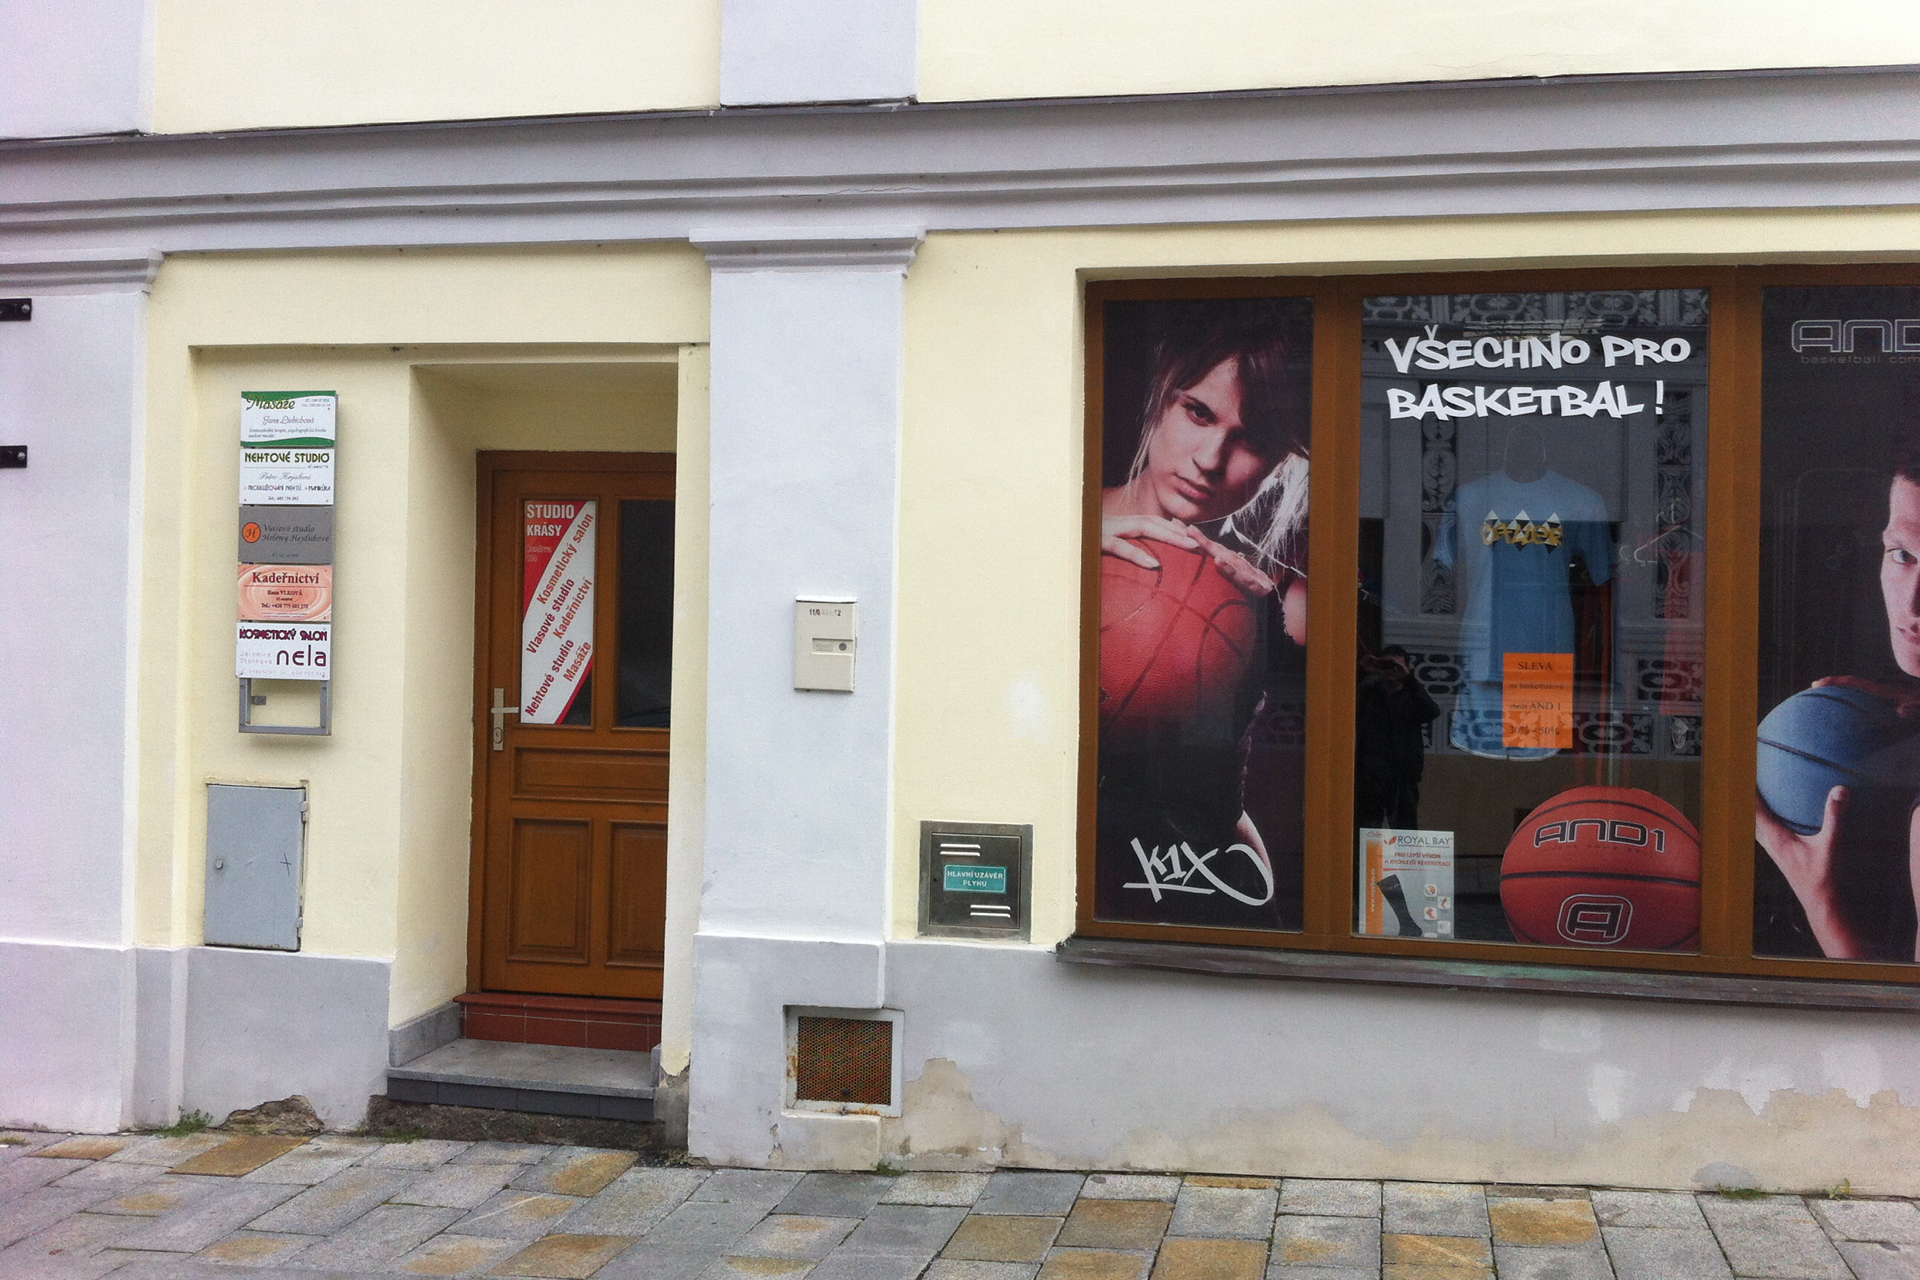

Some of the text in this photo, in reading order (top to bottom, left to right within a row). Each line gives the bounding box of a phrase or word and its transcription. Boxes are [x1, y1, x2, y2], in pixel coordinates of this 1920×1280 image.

[1383, 323, 1691, 374] VŠECHNO PRO
[1801, 355, 1880, 364] basketball
[1386, 379, 1664, 420] BASKETBAL !
[244, 451, 330, 463] NEHTOVÉ STUDIO
[526, 504, 575, 519] STUDIO
[292, 524, 316, 533] studio
[526, 521, 562, 536] KRÁSY
[536, 542, 578, 605] Kosmetický
[572, 513, 594, 543] salon
[252, 572, 320, 584] Kadeřnictví
[553, 576, 593, 639] Kadeřnictví
[526, 578, 575, 654] Vlasové studio
[239, 628, 328, 641] KOSMETICKÝ SALON
[276, 644, 327, 666] nela
[563, 641, 592, 682] Masáže
[1518, 661, 1553, 671] SLEVA
[524, 639, 574, 717] Nehtové studio
[1529, 702, 1554, 711] AND
[1397, 835, 1451, 846] ROYAL BAY
[1533, 818, 1666, 853] AND1
[947, 870, 1003, 879] HLAVNÍ UZÁVĚR
